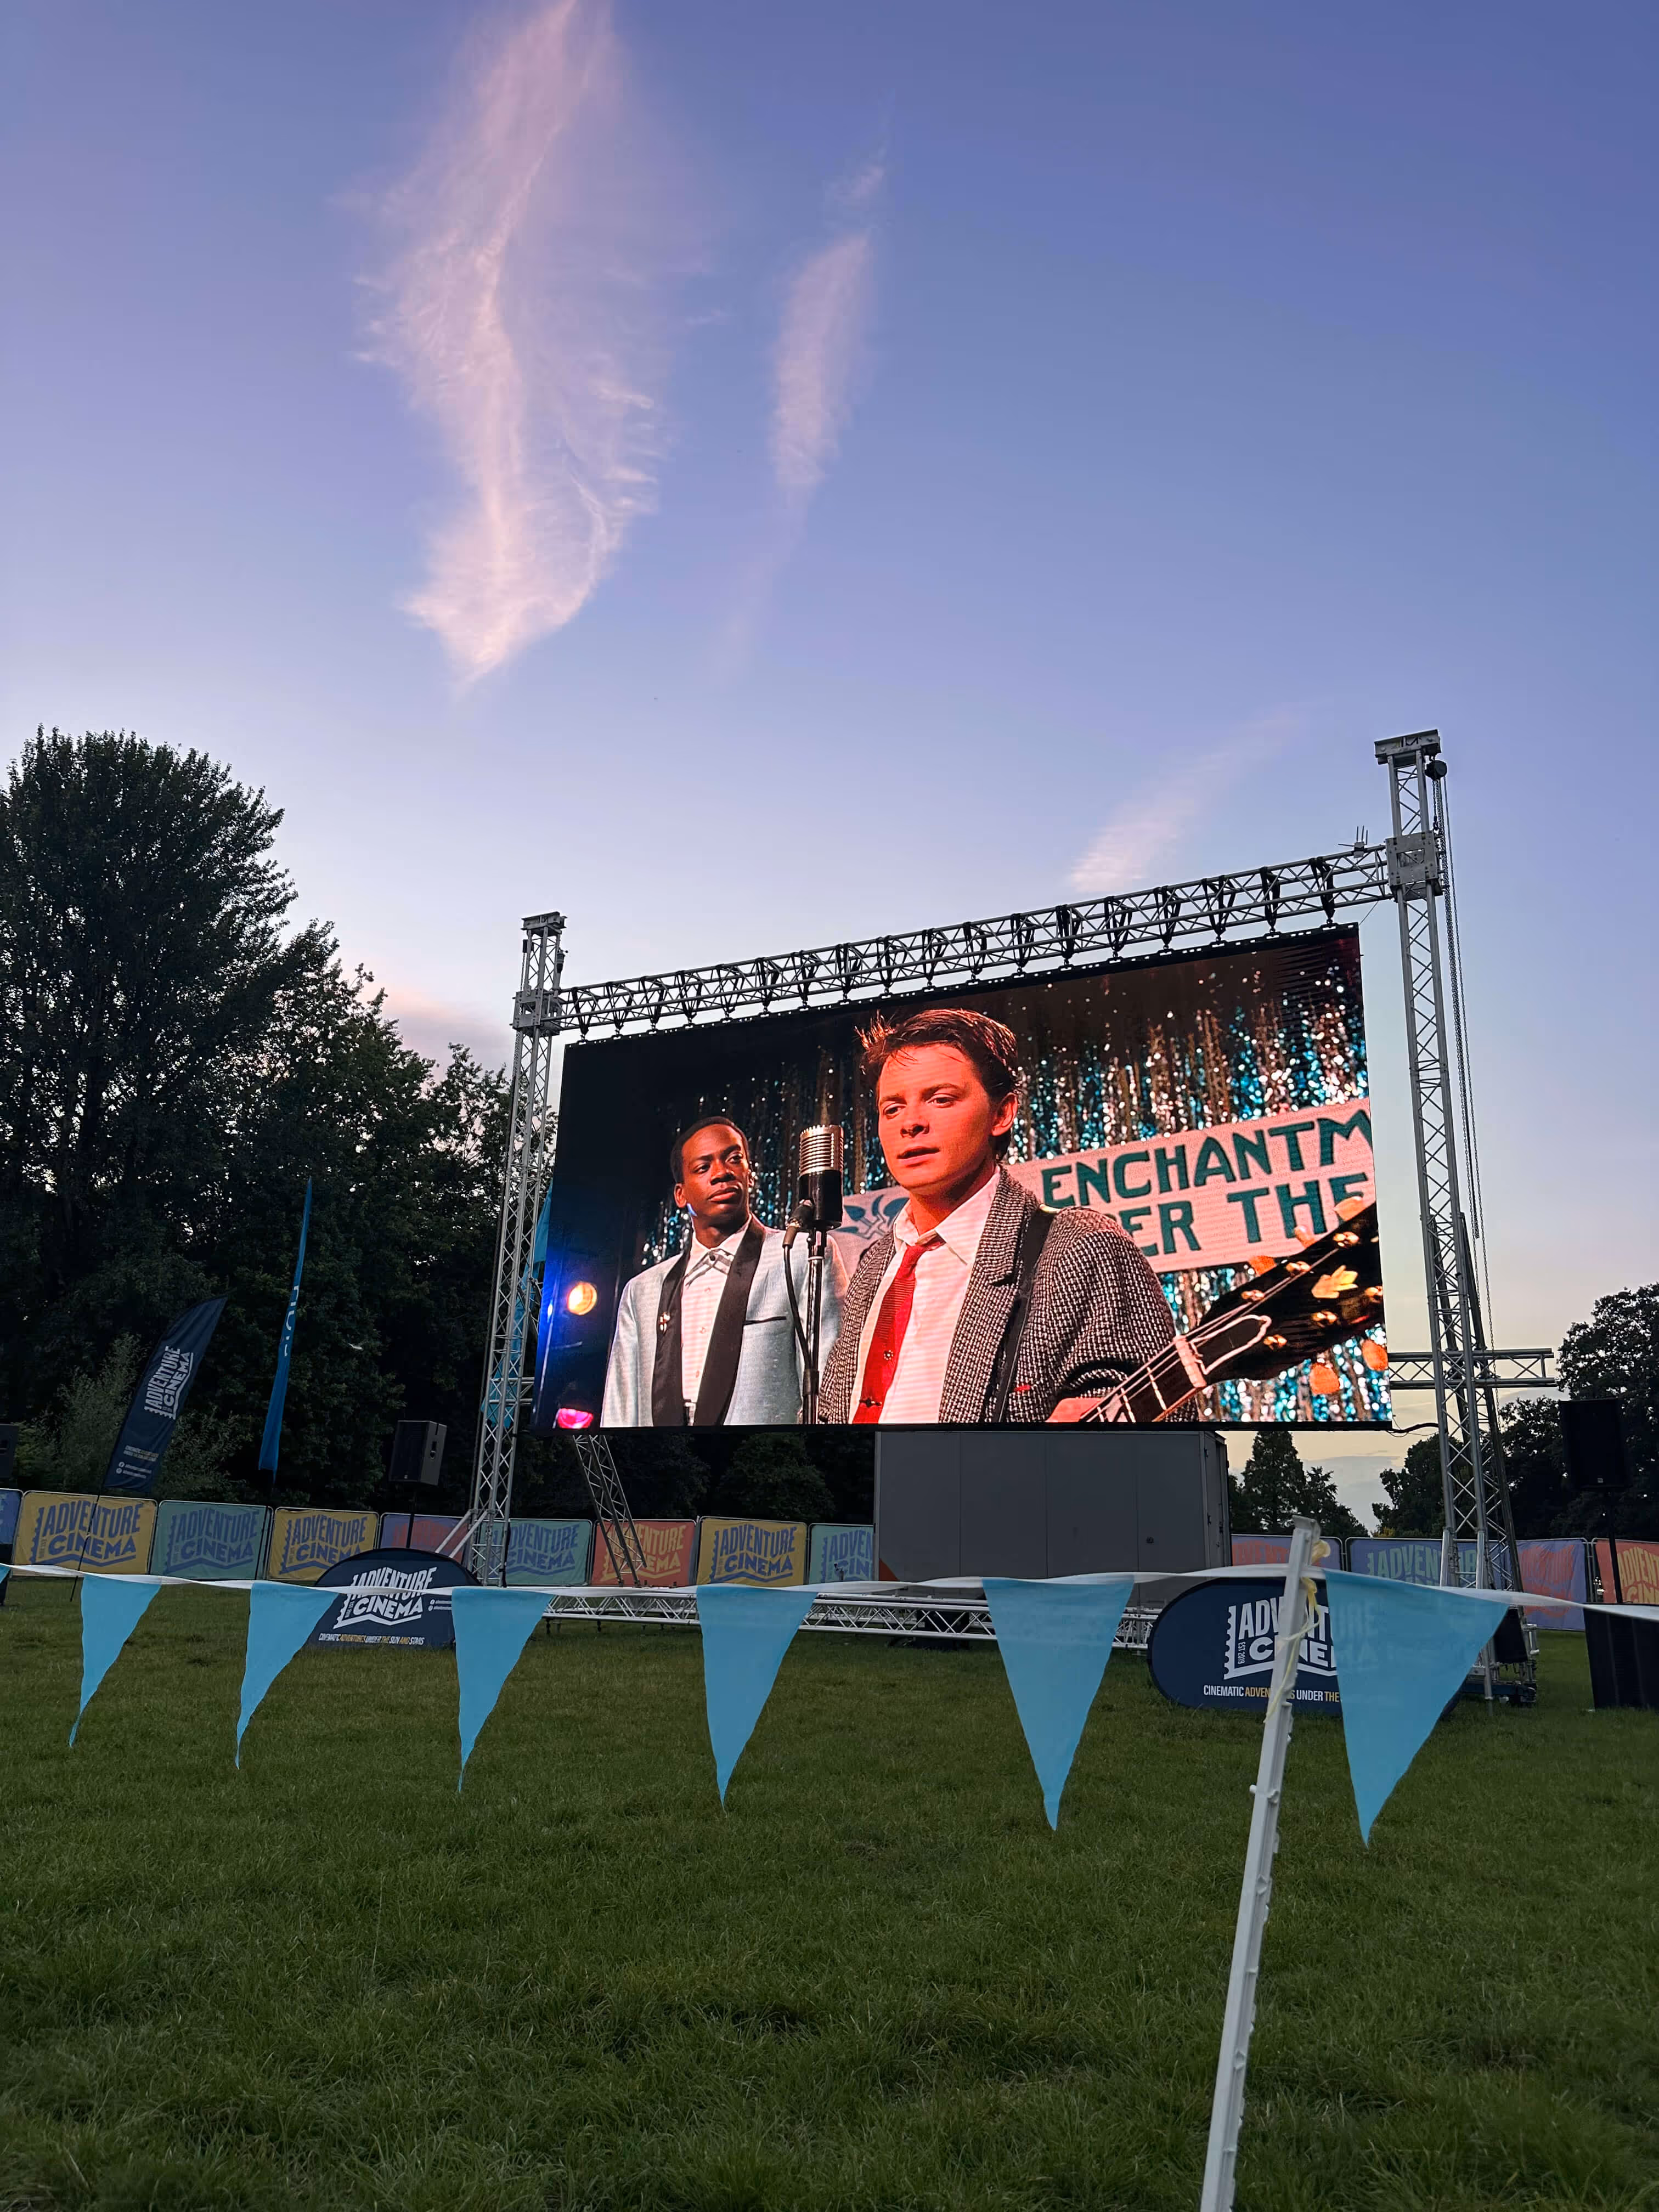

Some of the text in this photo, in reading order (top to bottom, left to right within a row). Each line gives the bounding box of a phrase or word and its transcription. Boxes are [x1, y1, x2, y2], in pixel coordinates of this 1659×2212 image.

[1104, 1200, 1201, 1257] ER
[145, 1346, 180, 1409] ADVENTURE
[163, 1352, 190, 1407] CINEMA
[42, 1500, 144, 1538] ADVENTURE
[176, 1509, 259, 1543] ADVENTURE
[292, 1514, 368, 1547] ADVENTURE
[48, 1532, 137, 1559] CINEMA
[180, 1538, 253, 1562] CINEMA
[510, 1523, 580, 1553] DVENTURE
[720, 1523, 797, 1558] ADVENTURE
[725, 1553, 793, 1577] CINEMA
[353, 1596, 424, 1620] CINEMA
[1203, 1685, 1244, 1697] CINEMATIC
[1296, 1689, 1324, 1701] UNDER
[1324, 1691, 1340, 1702] THE
